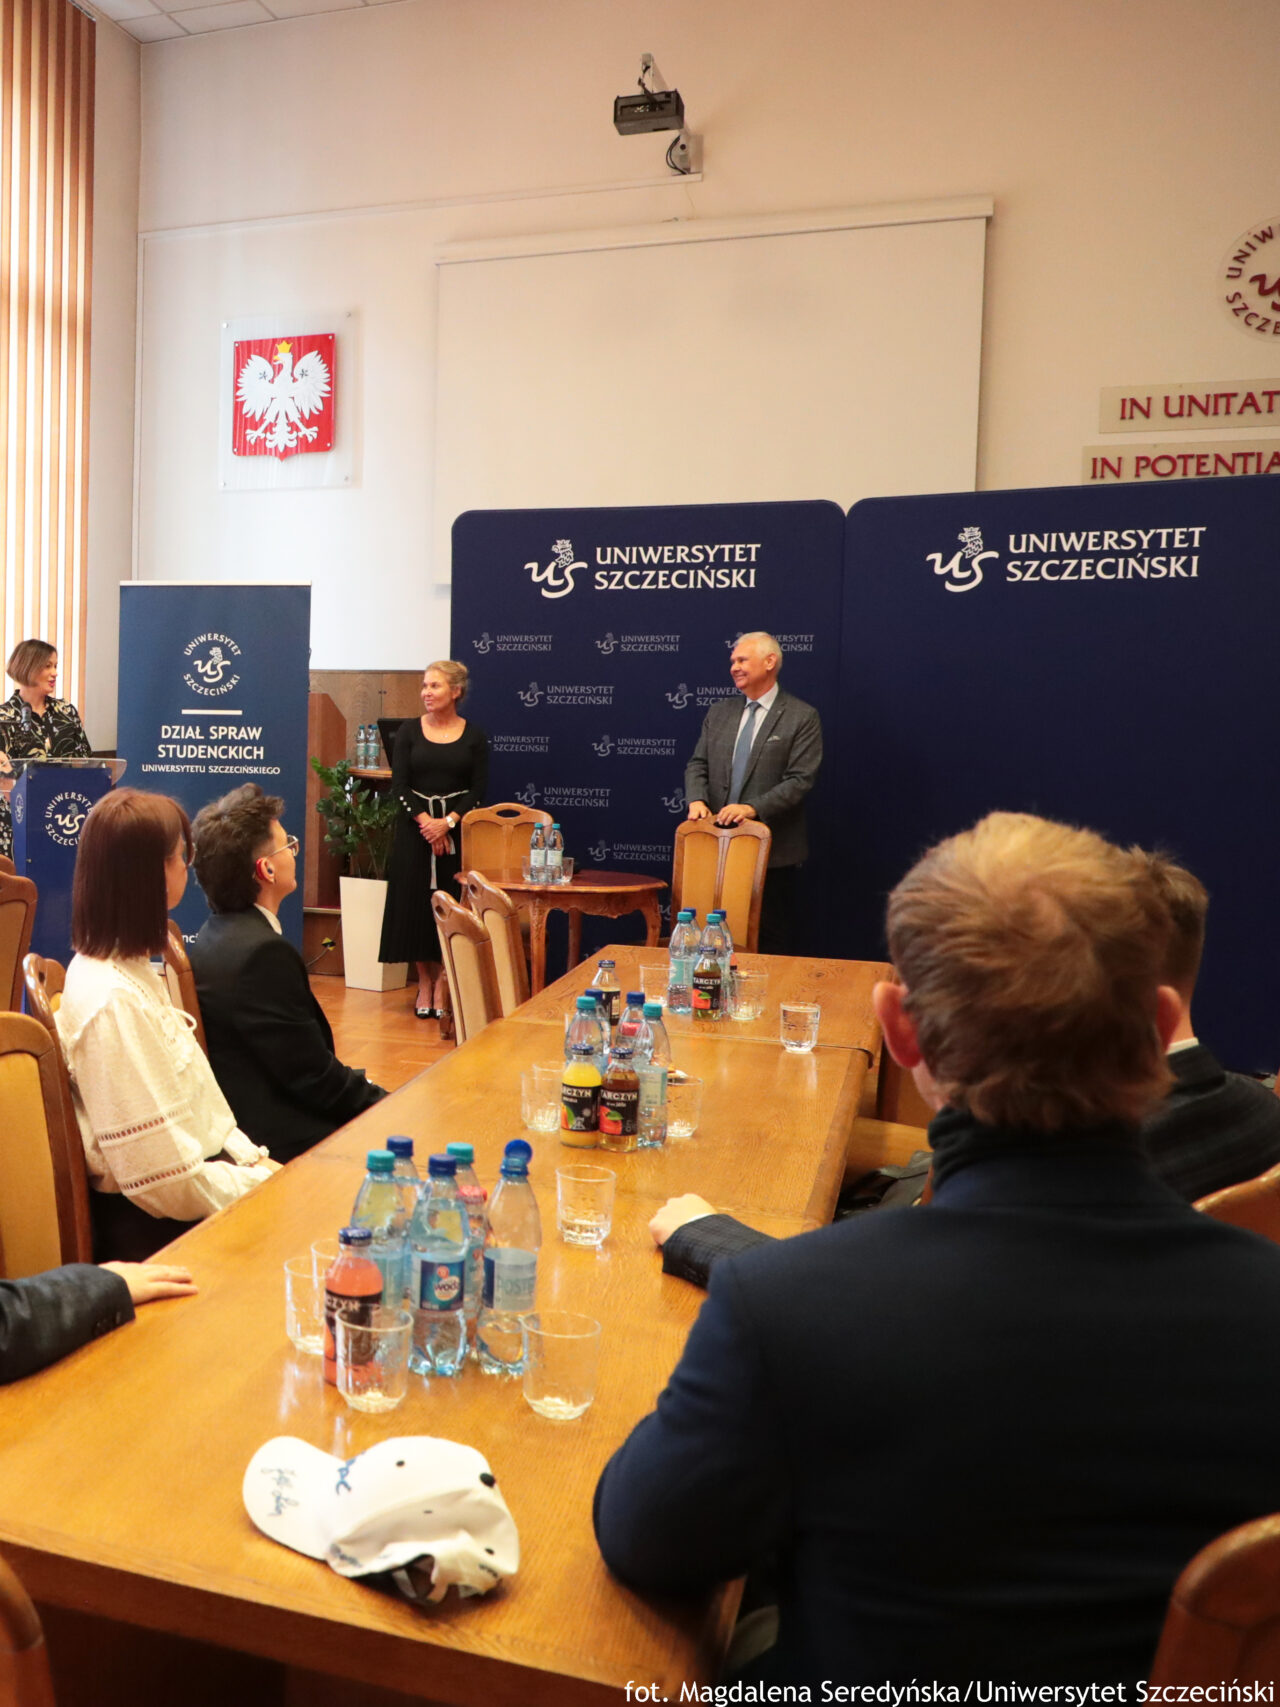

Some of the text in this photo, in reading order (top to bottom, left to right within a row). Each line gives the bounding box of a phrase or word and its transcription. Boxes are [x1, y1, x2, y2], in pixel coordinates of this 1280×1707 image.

[1226, 225, 1280, 280] UNIW
[1120, 390, 1280, 420] IN UNITAT
[1090, 456, 1122, 479] IN
[1008, 527, 1207, 554] UNIWERSYTET
[596, 543, 762, 565] UNIWERSYTET
[1006, 553, 1200, 582] SZCZECIŃSKI
[594, 565, 756, 590] SZCZECIŃSKI
[183, 633, 242, 656] UNIWERSYTET
[496, 635, 553, 643] UNIWERSYTET
[620, 635, 681, 643] UNIWERSYTET
[183, 673, 241, 696] SZCZECIŃSKI
[546, 685, 615, 695] UNIWERSYTET
[696, 686, 744, 697] UNIWERS
[161, 725, 262, 740] DZIAŁ SPRAW
[493, 735, 550, 744] UNIWERSYTET
[157, 744, 264, 760] STUDENCKICH
[617, 738, 677, 747] UNIWERSYTET
[141, 764, 281, 775] UNIWERSYTETU SZCZECIŃSKIEGO
[543, 786, 611, 797] UNIWERSYTET
[44, 791, 94, 818] UNIWERSYTE
[45, 823, 81, 846] SZCZECI
[613, 842, 672, 852] UNIWERSYTET
